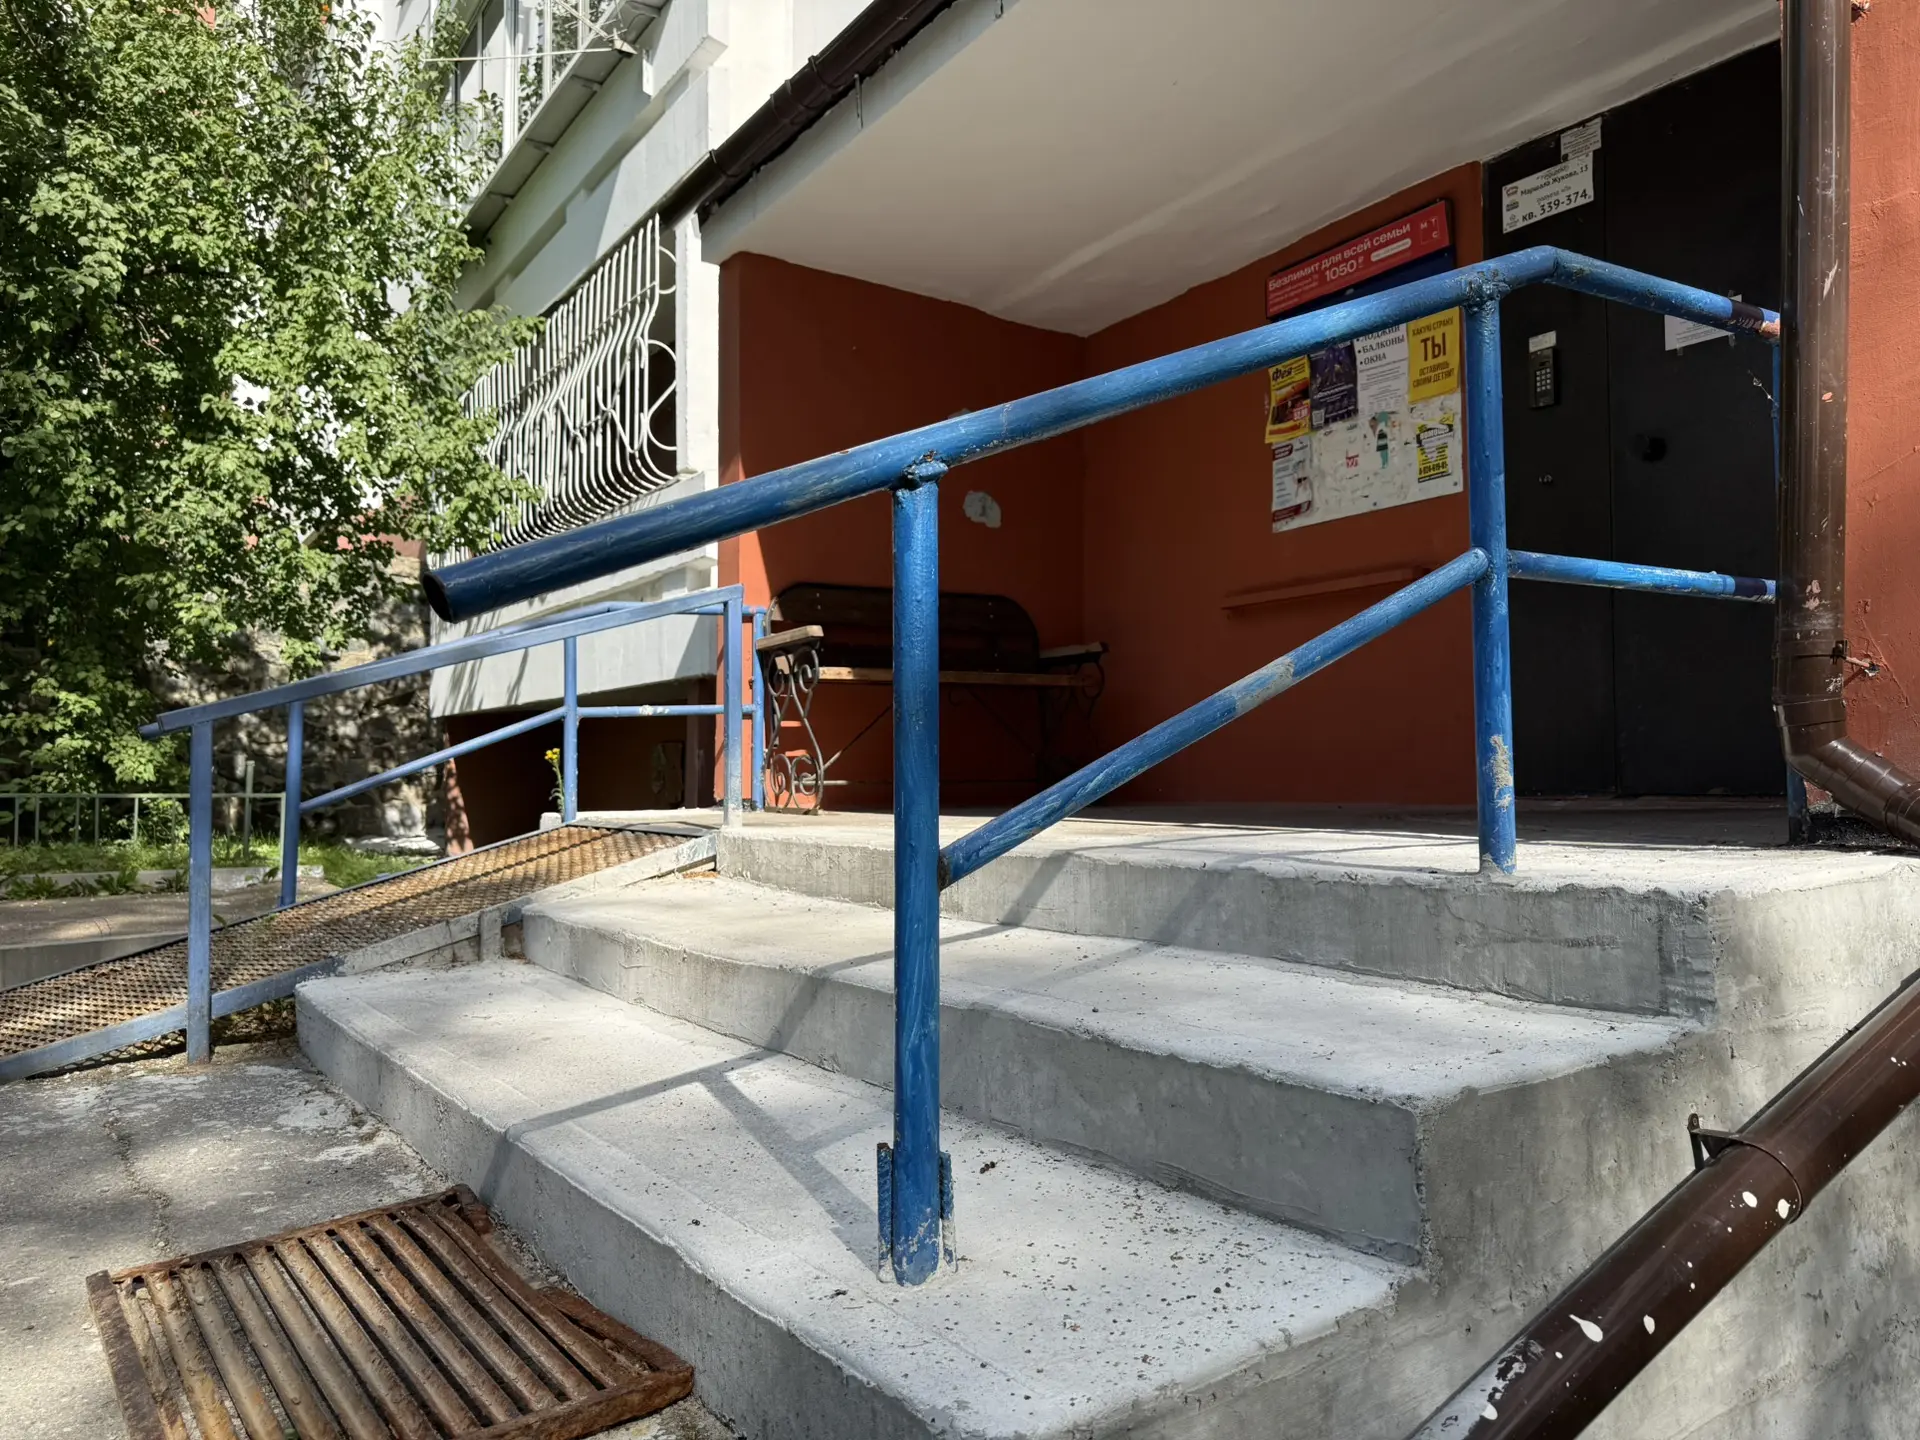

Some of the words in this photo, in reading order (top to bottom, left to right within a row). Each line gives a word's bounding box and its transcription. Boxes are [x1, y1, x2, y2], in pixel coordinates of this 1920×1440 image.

[1539, 188, 1588, 215] 339-374
[1268, 264, 1321, 291] Безлимит
[1321, 253, 1342, 270] для
[1343, 238, 1372, 258] всей
[1373, 223, 1411, 246] семьи
[1324, 260, 1357, 282] 1050
[1432, 316, 1454, 331] СТРАНУ
[1362, 334, 1405, 354] БАЛКОНЫ
[1420, 332, 1447, 362] ТЫ
[1363, 352, 1387, 366] ОКНА
[1412, 375, 1432, 388] СВОИМ
